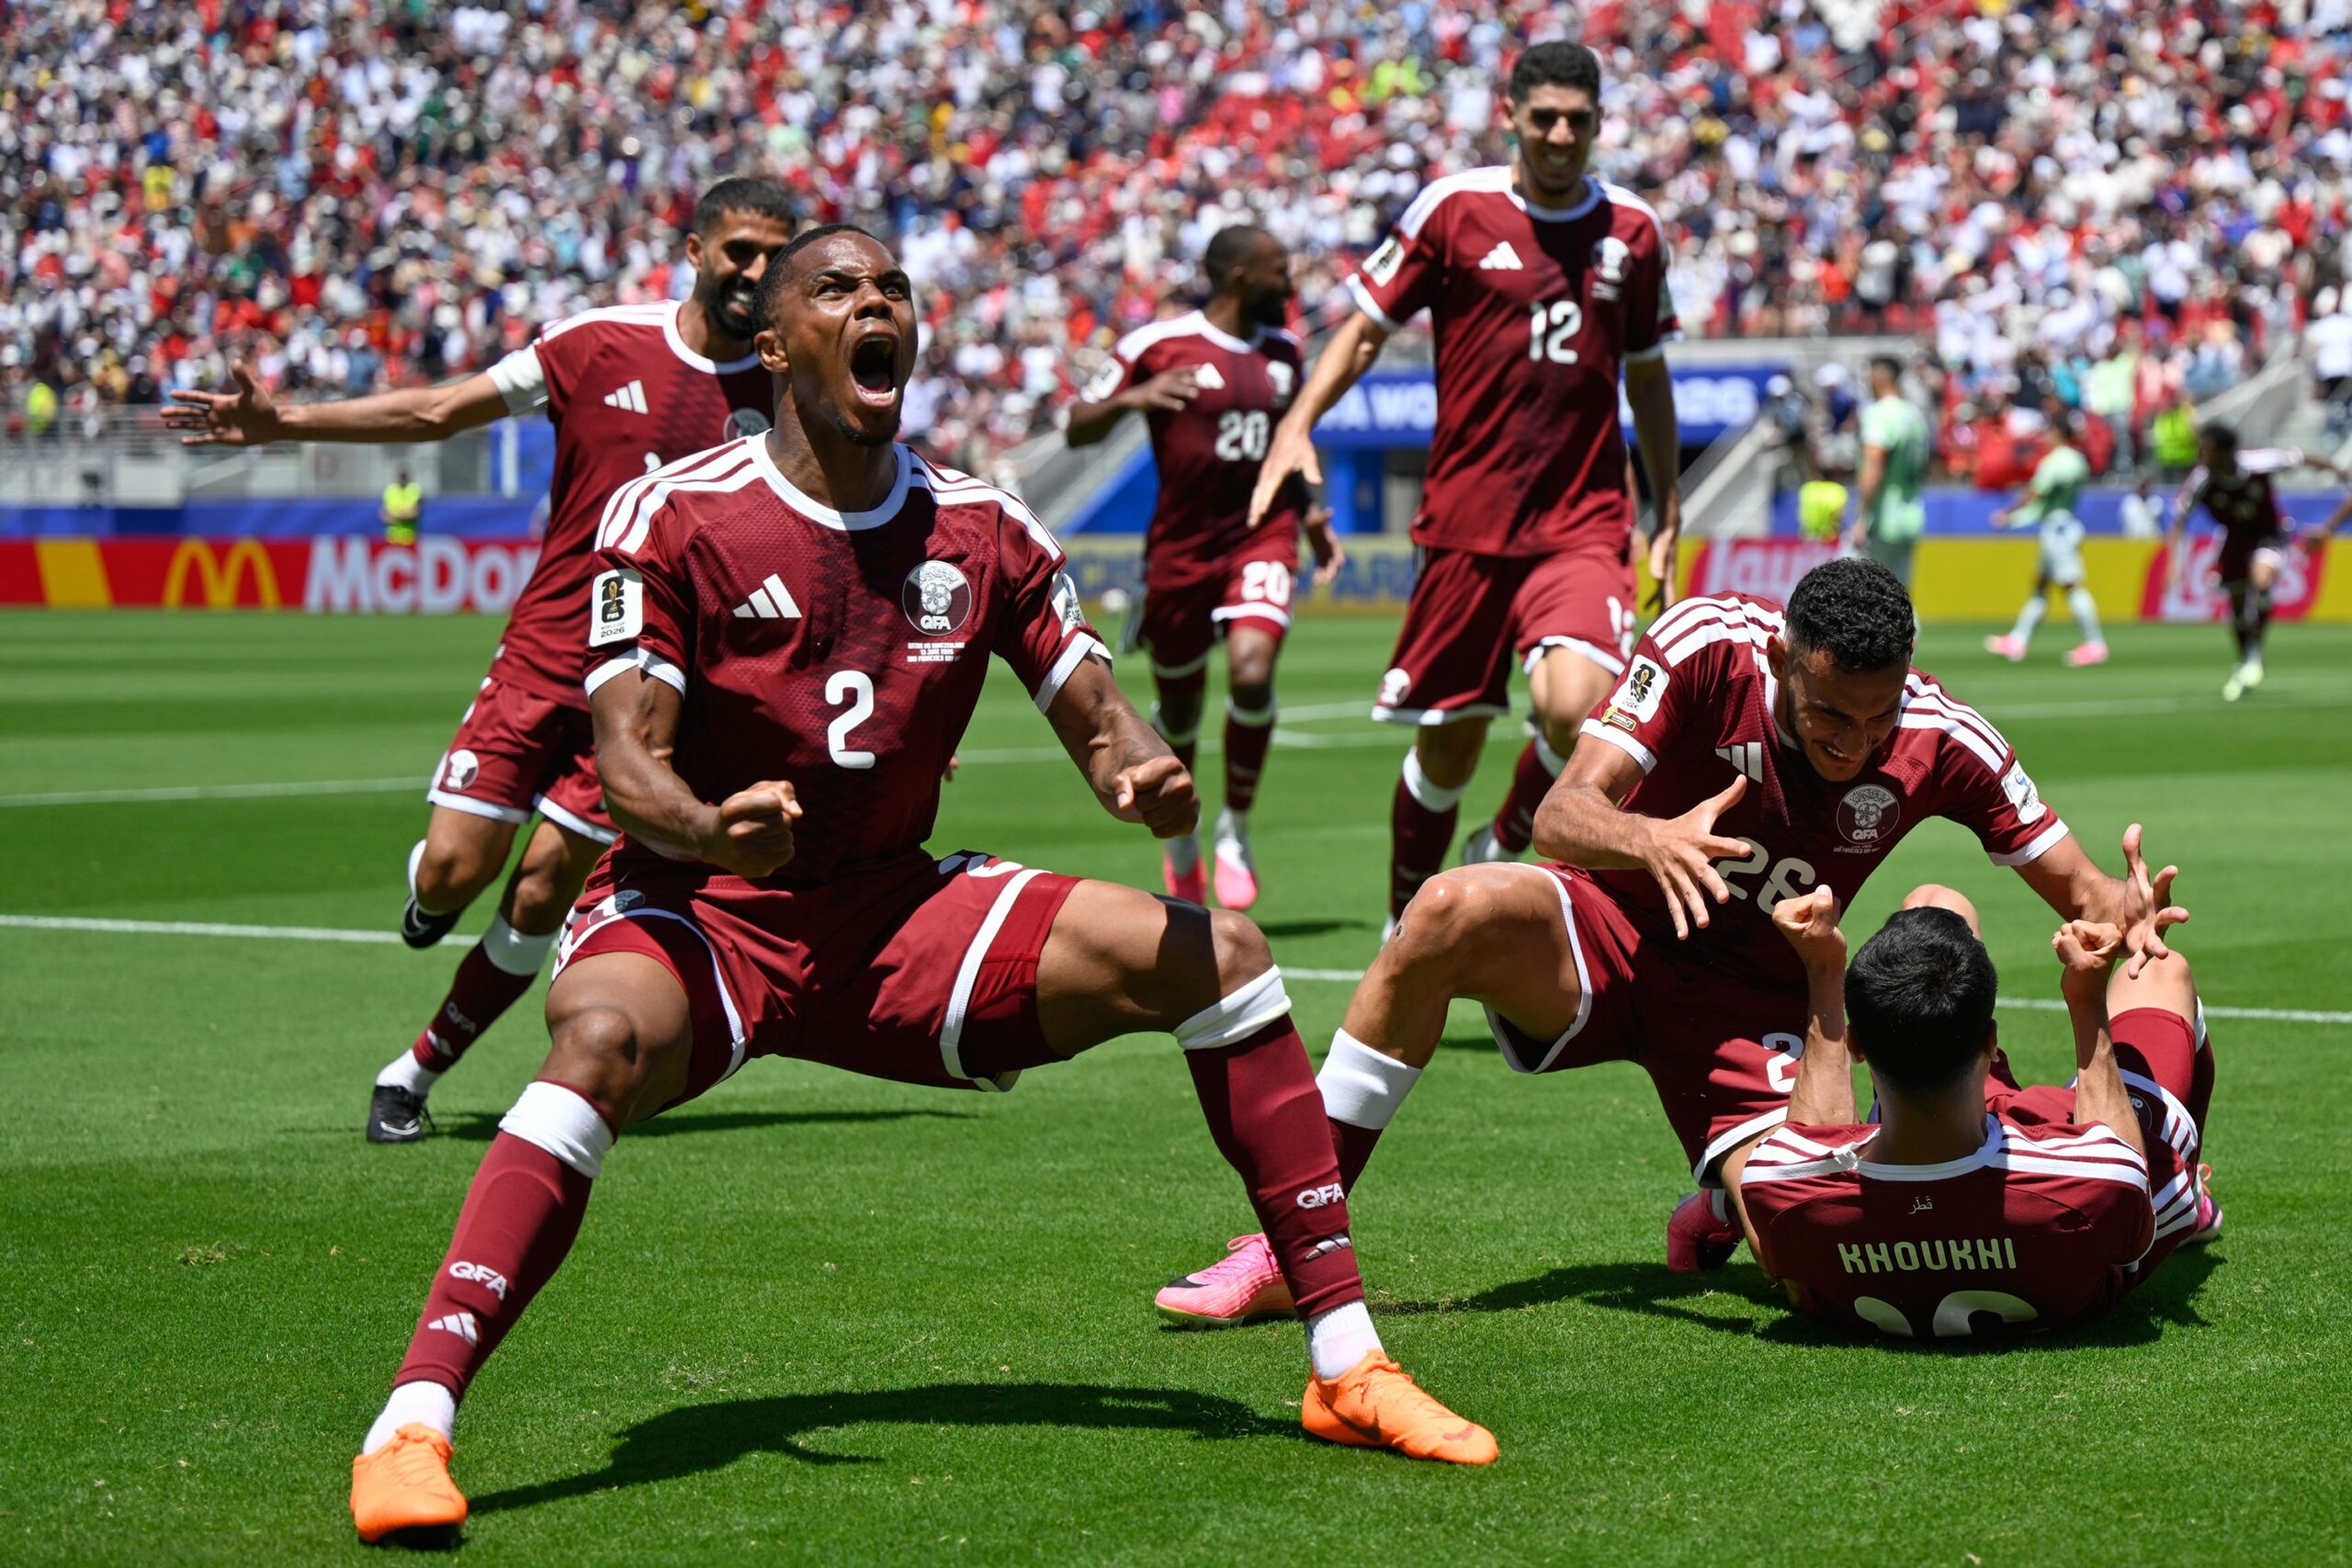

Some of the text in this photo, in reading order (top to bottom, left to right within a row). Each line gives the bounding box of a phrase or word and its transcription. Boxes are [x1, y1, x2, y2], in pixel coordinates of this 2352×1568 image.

[1529, 300, 1582, 364] 12
[1369, 381, 1439, 430] WO
[1215, 410, 1269, 461] 20
[1242, 560, 1290, 604] 20
[601, 626, 625, 637] 2026
[920, 615, 952, 630] QFA
[826, 671, 876, 769] 2
[1852, 829, 1878, 840] QFA
[1716, 837, 1816, 916] 26
[447, 1001, 476, 1034] QFA
[1296, 1183, 1345, 1209] QFA
[1838, 1237, 2017, 1274] KHOUKHI
[449, 1260, 507, 1301] QFA
